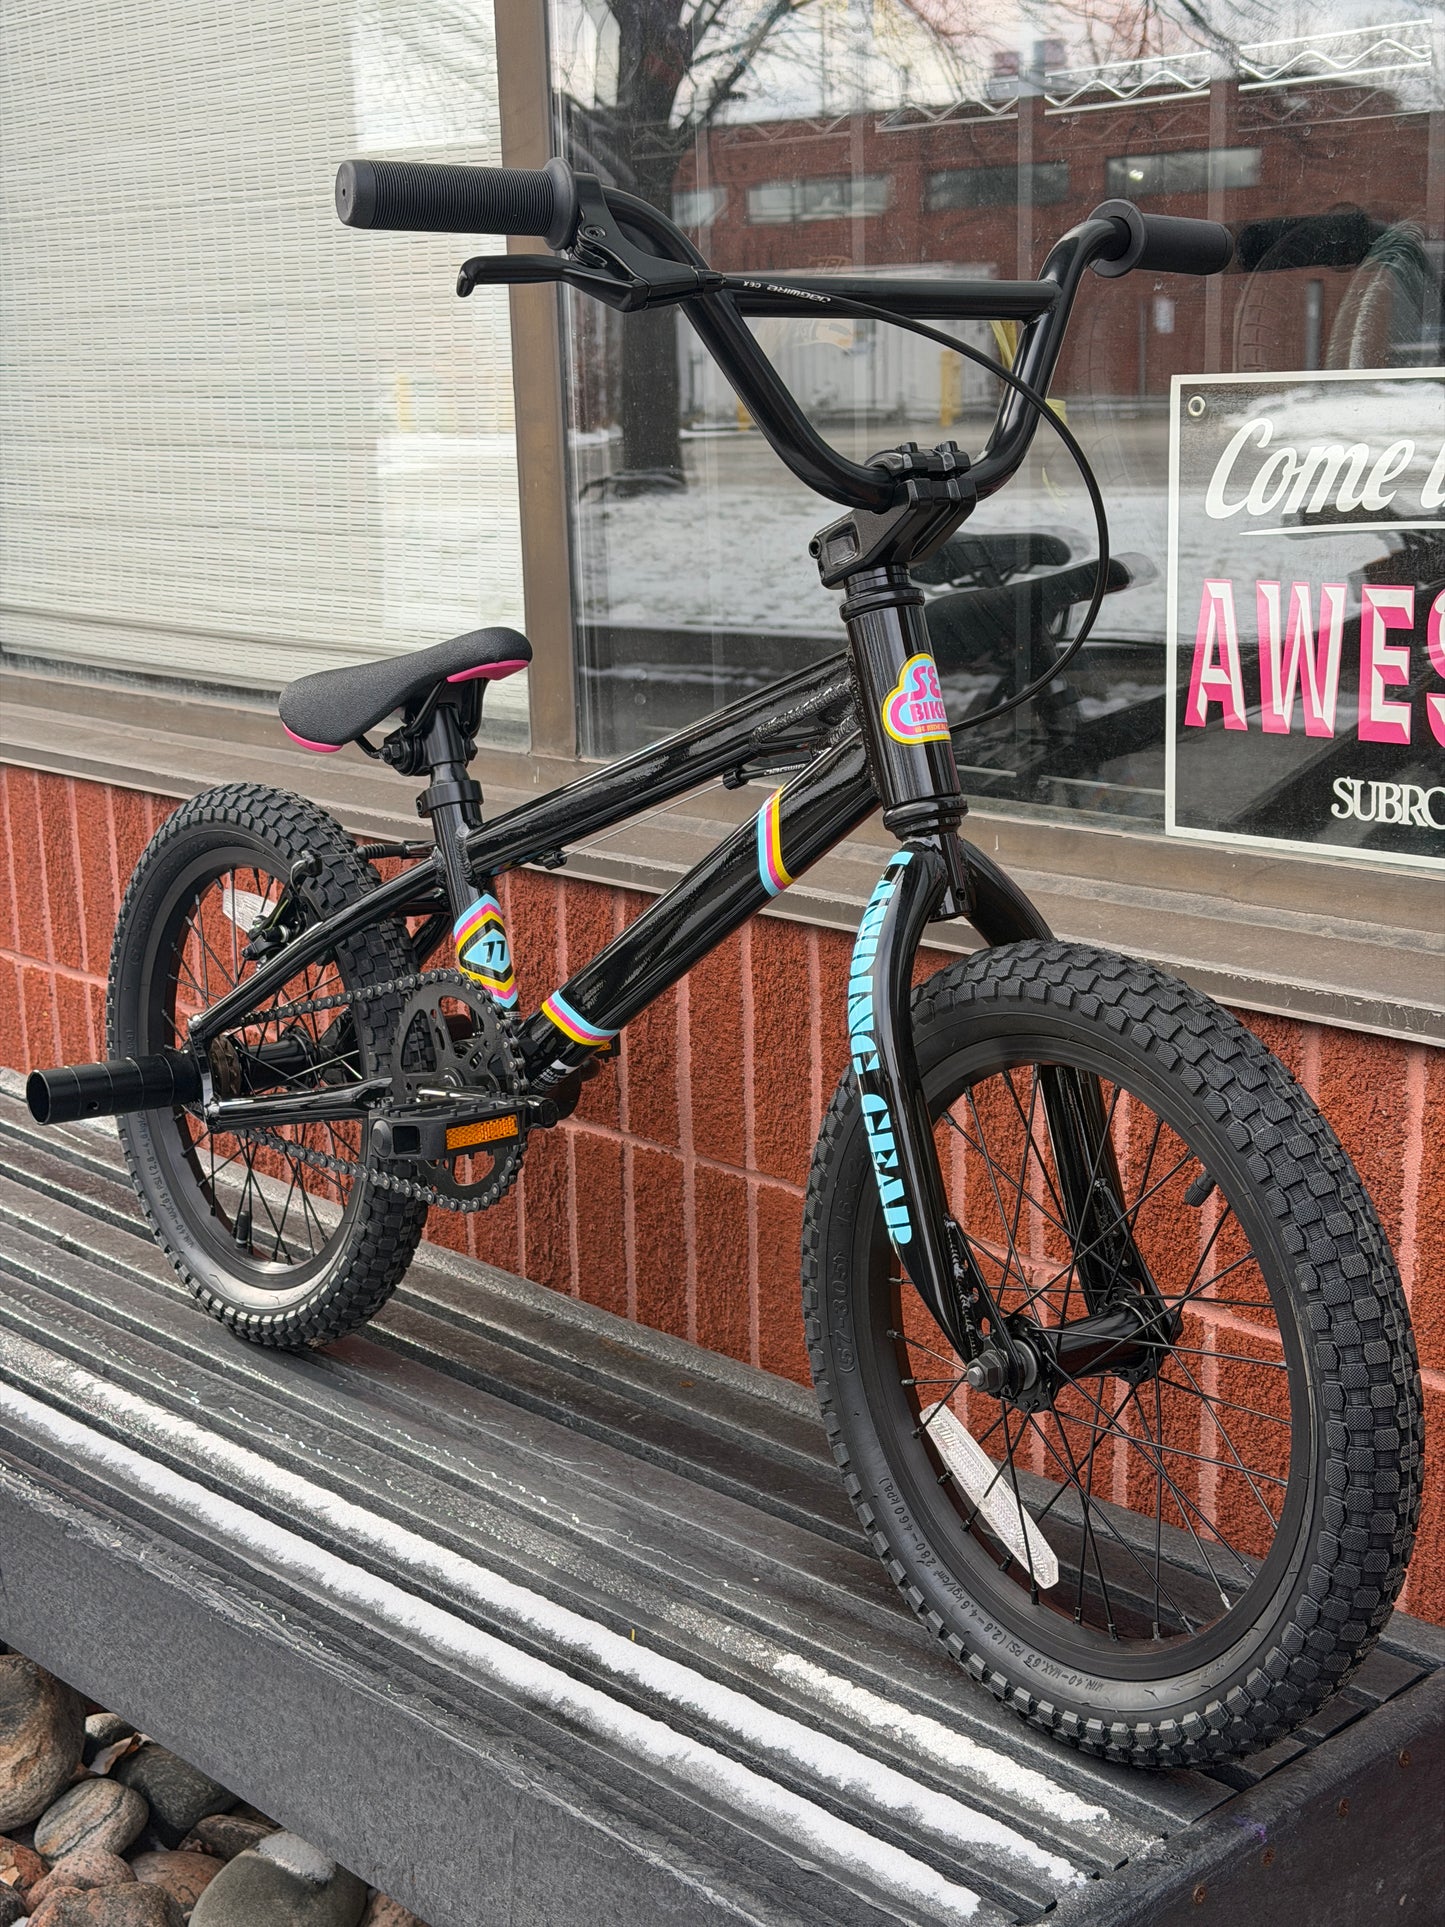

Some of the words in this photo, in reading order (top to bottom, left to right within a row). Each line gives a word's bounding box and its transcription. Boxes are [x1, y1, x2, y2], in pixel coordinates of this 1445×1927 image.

[1205, 417, 1415, 519] Come
[483, 940, 506, 963] 77
[862, 1093, 912, 1245] GEAR
